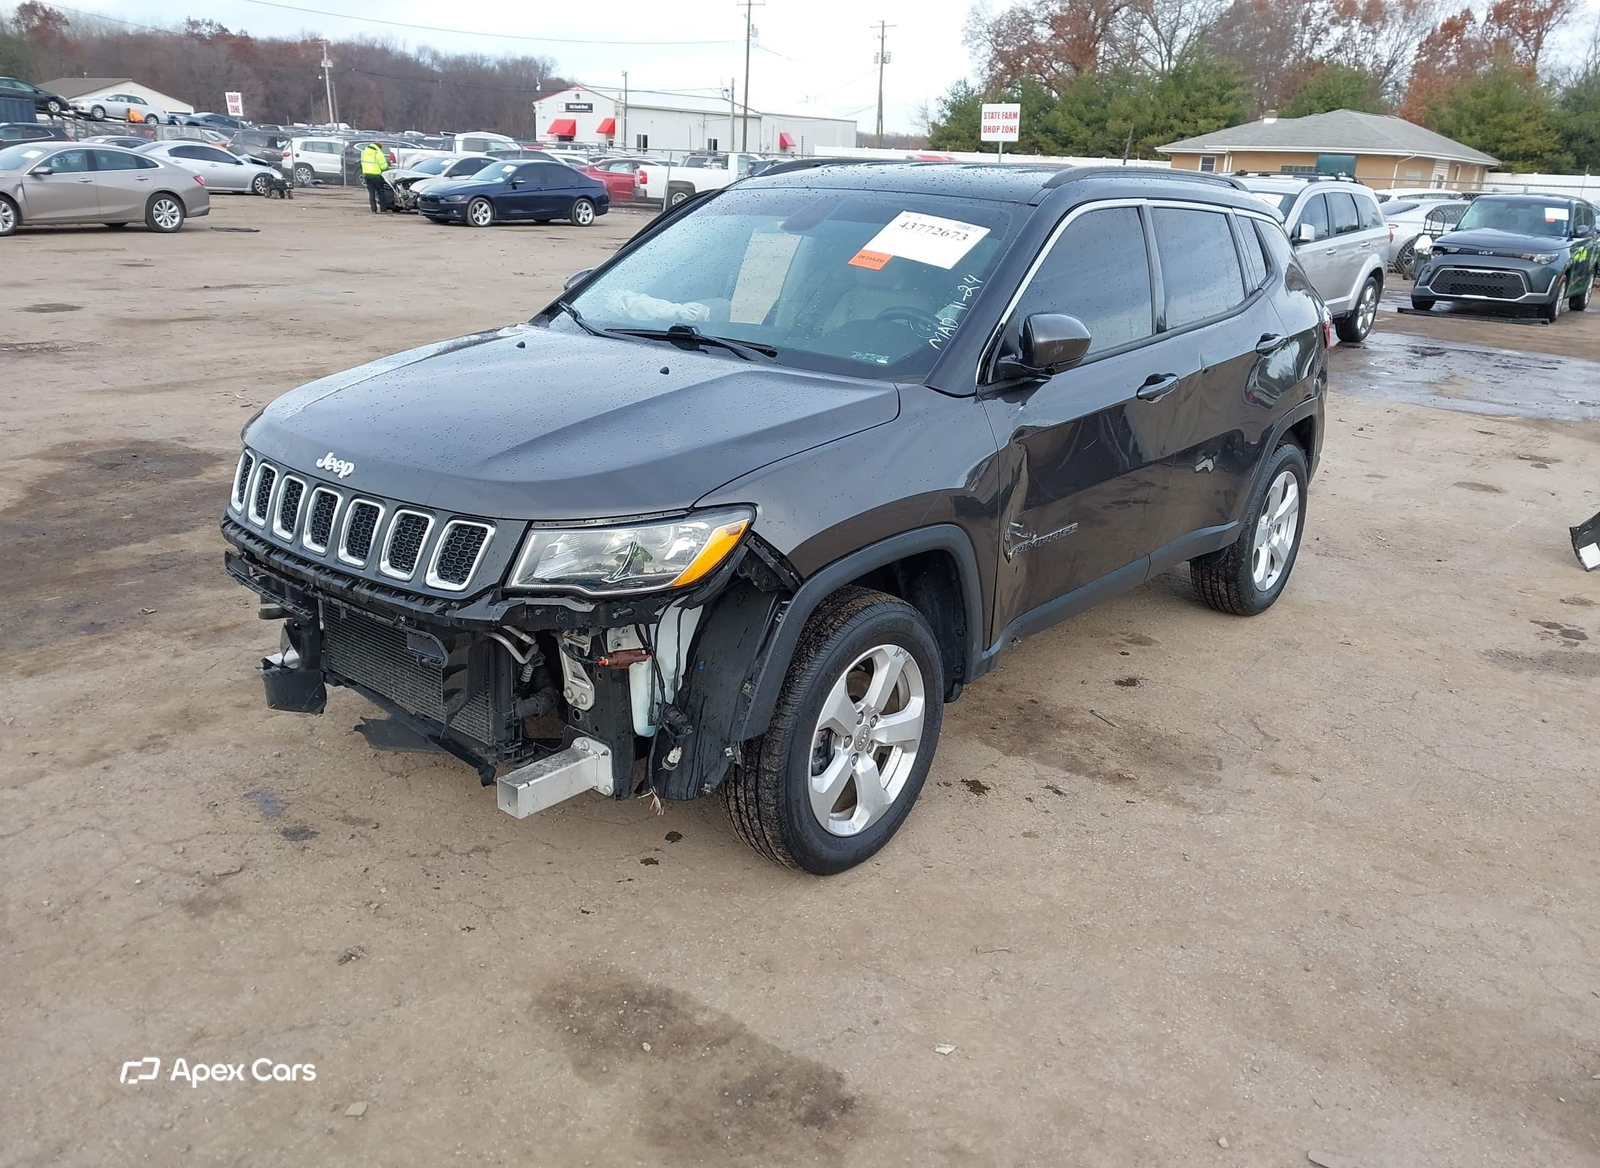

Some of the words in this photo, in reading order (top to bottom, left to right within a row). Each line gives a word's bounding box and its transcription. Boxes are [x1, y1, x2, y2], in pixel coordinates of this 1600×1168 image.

[983, 111, 1001, 120] STATE
[1001, 111, 1018, 120] FARM
[983, 125, 1001, 134] DROP
[1001, 125, 1017, 134] ZONE
[899, 221, 970, 242] 43772673
[858, 254, 885, 263] DETAILED
[928, 316, 960, 351] MAD
[315, 451, 355, 479] Jeep
